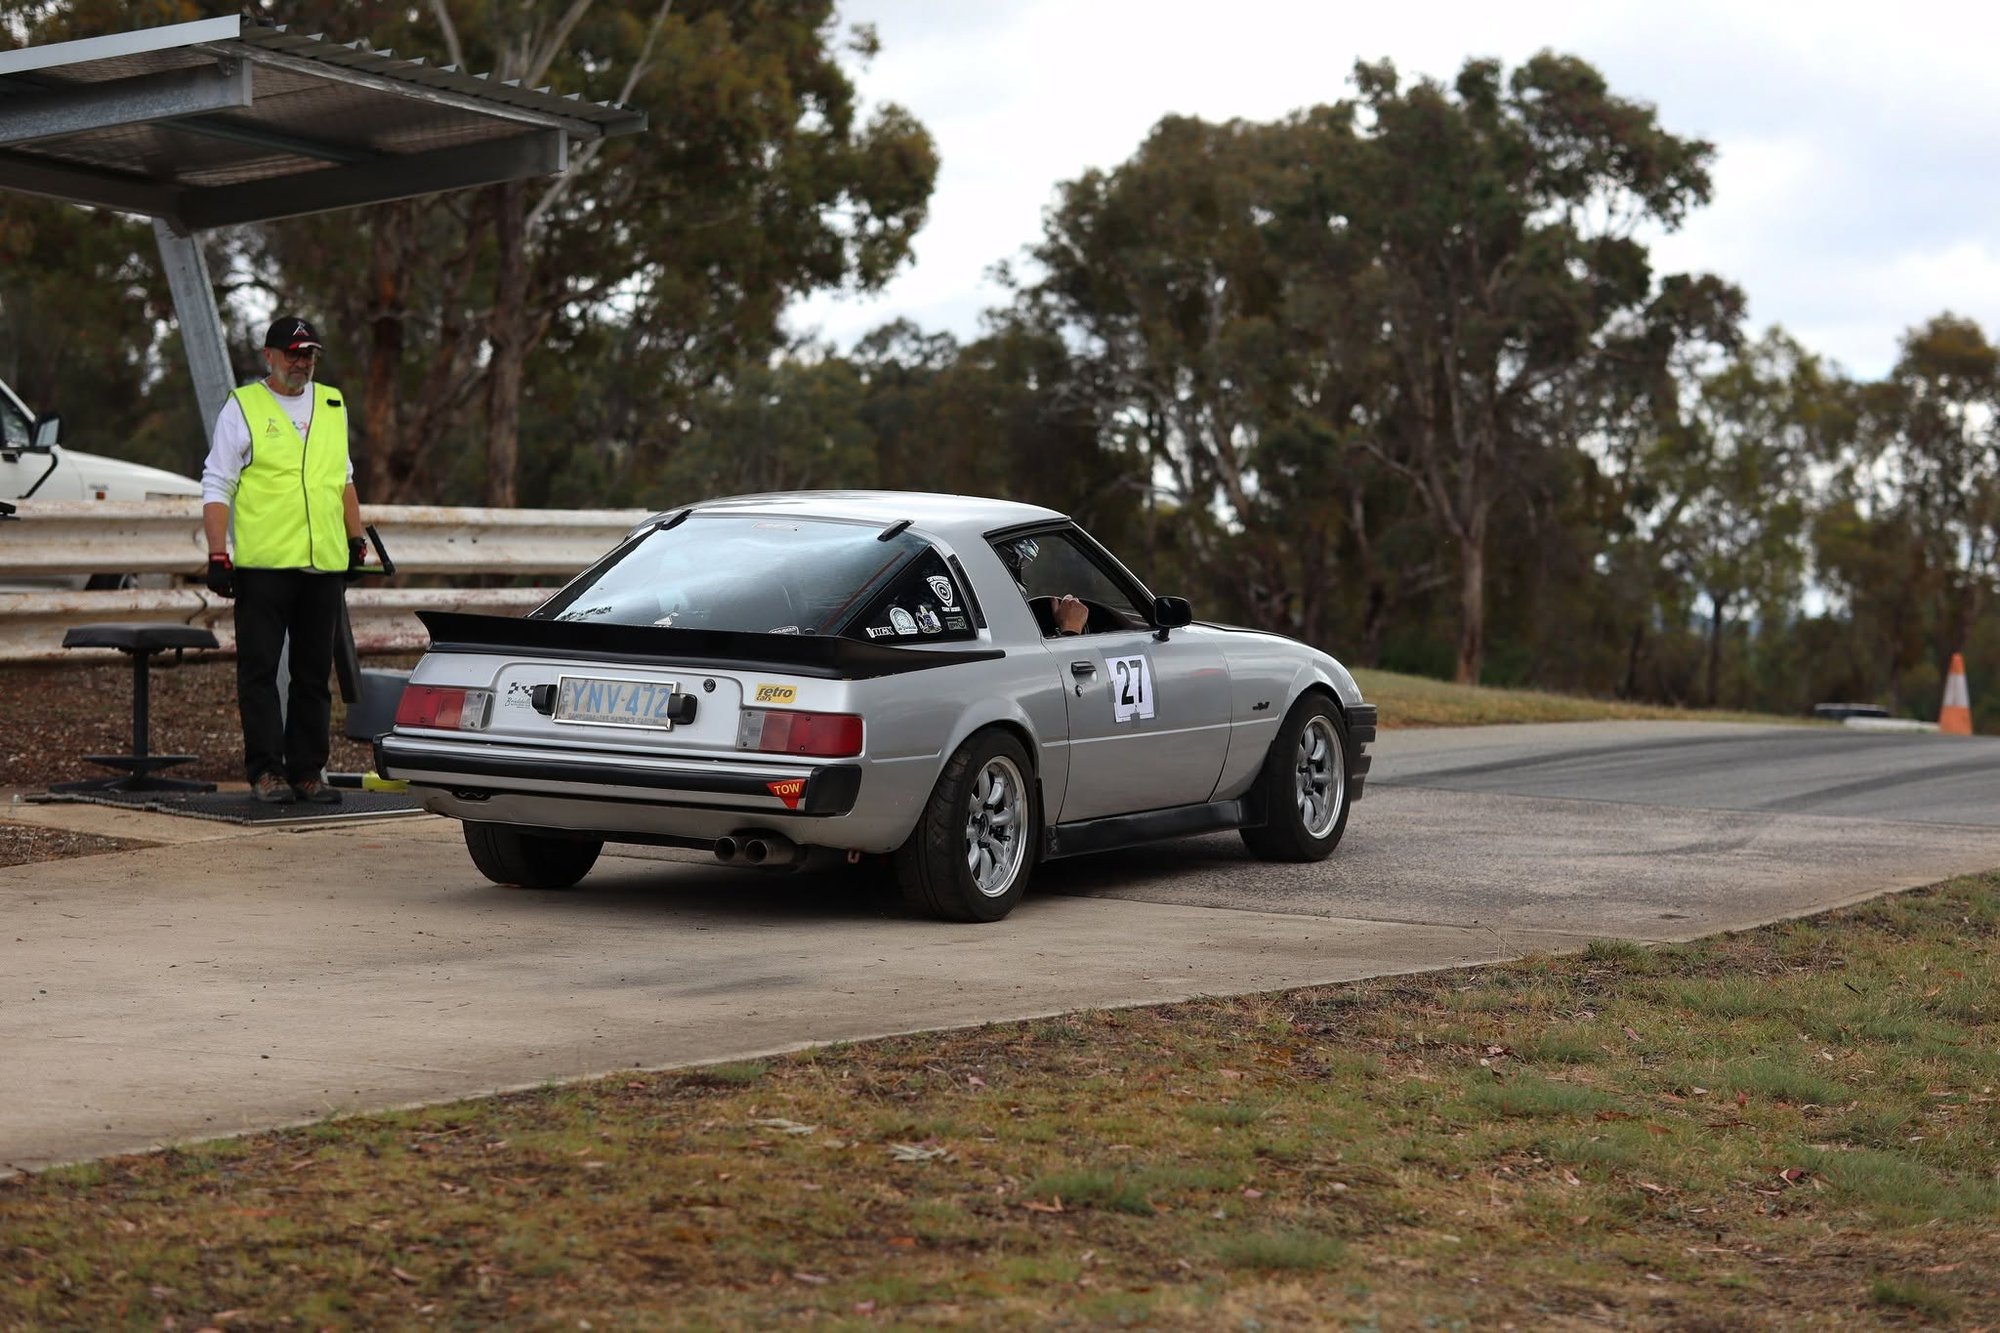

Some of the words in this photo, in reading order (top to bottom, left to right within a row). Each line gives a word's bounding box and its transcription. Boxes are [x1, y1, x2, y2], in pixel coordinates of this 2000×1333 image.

[1116, 660, 1143, 705] 27
[758, 687, 793, 698] retro
[774, 783, 799, 795] TOW
